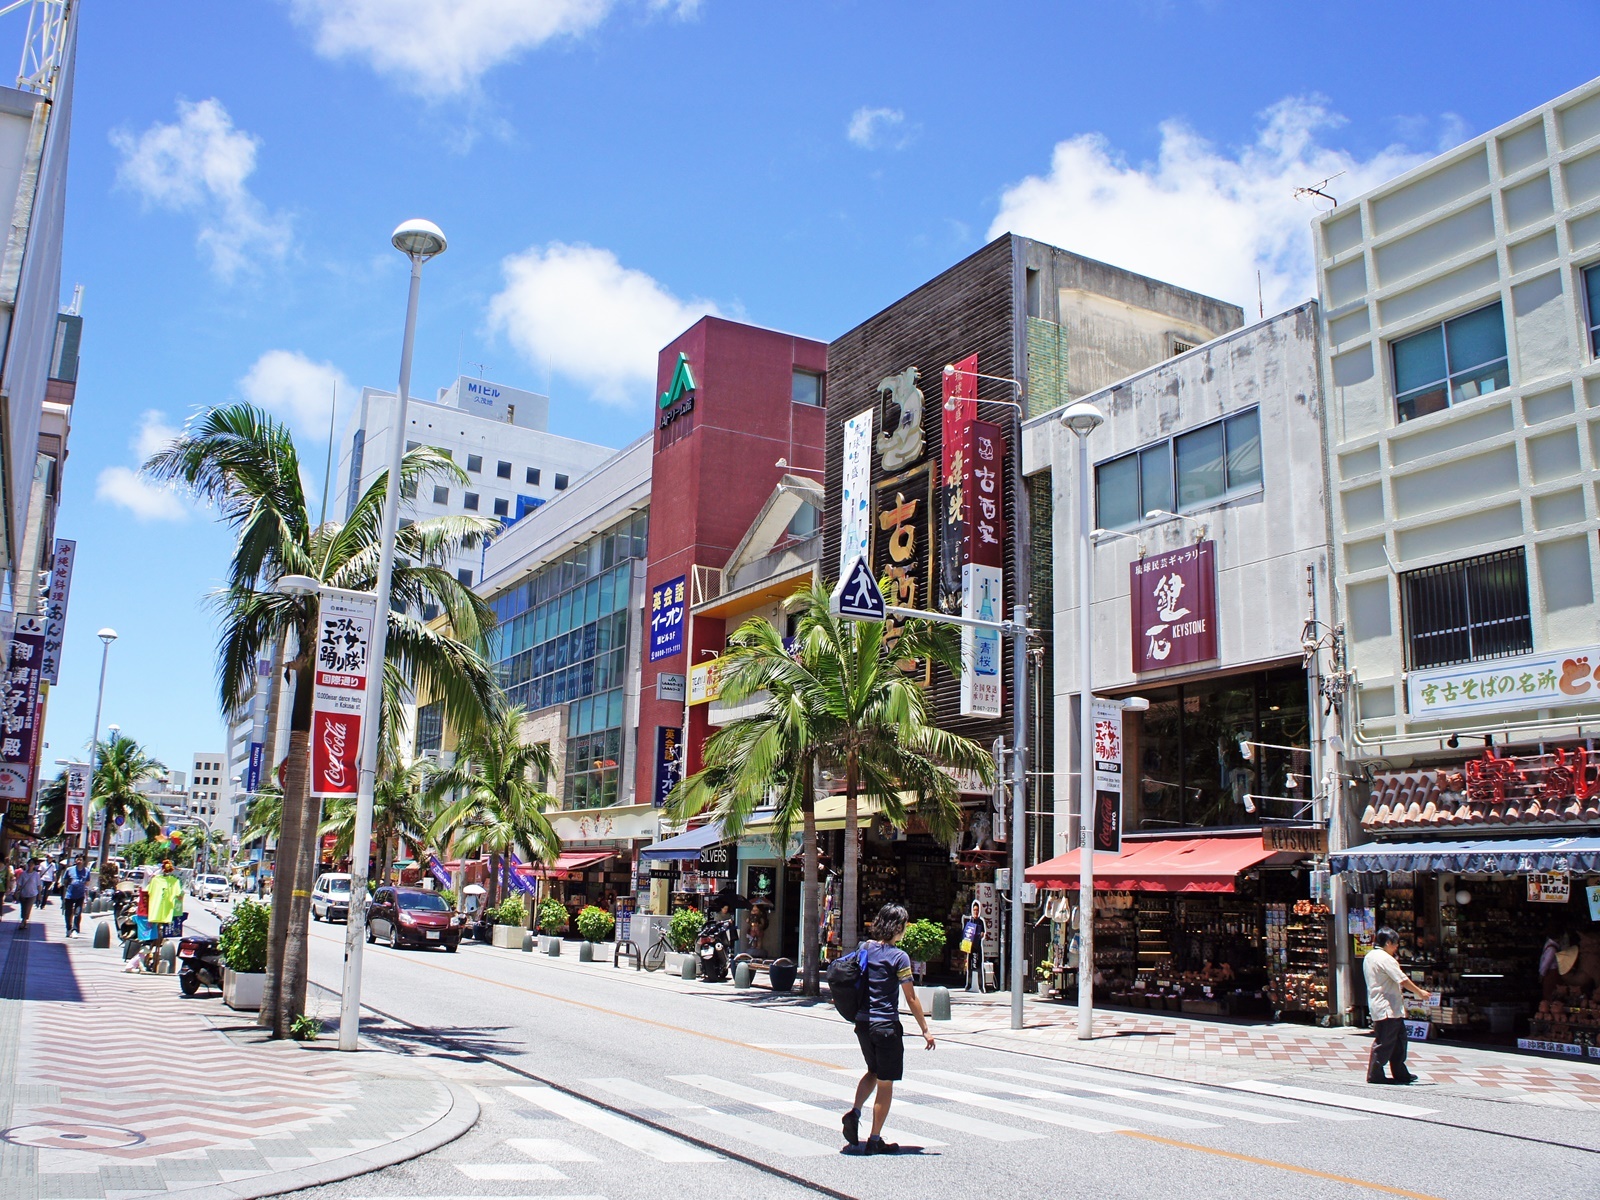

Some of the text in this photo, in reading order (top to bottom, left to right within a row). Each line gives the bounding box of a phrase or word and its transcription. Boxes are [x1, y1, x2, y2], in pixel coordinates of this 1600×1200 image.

[468, 382, 501, 398] MIビル
[474, 396, 493, 407] 久茂地
[974, 465, 999, 545] 古酒家
[1135, 549, 1207, 575] 琉球民芸ギャラリー
[653, 581, 684, 612] 英会話
[325, 618, 364, 632] 一万人の
[651, 606, 683, 632] イーオン
[1172, 618, 1206, 639] KEYSTONE
[321, 629, 367, 651] エイサー
[656, 631, 676, 646] ビル3F
[979, 642, 991, 667] 青桜
[322, 674, 359, 687] 国際通り
[973, 682, 998, 694] 全国発送
[1421, 669, 1557, 705] 宮古そばの名所
[973, 693, 998, 702] 承ります。
[664, 729, 675, 760] 英会話
[7, 768, 26, 783] TOMATO
[1271, 829, 1321, 850] KEYSTONE
[701, 849, 727, 863] SILVERS
